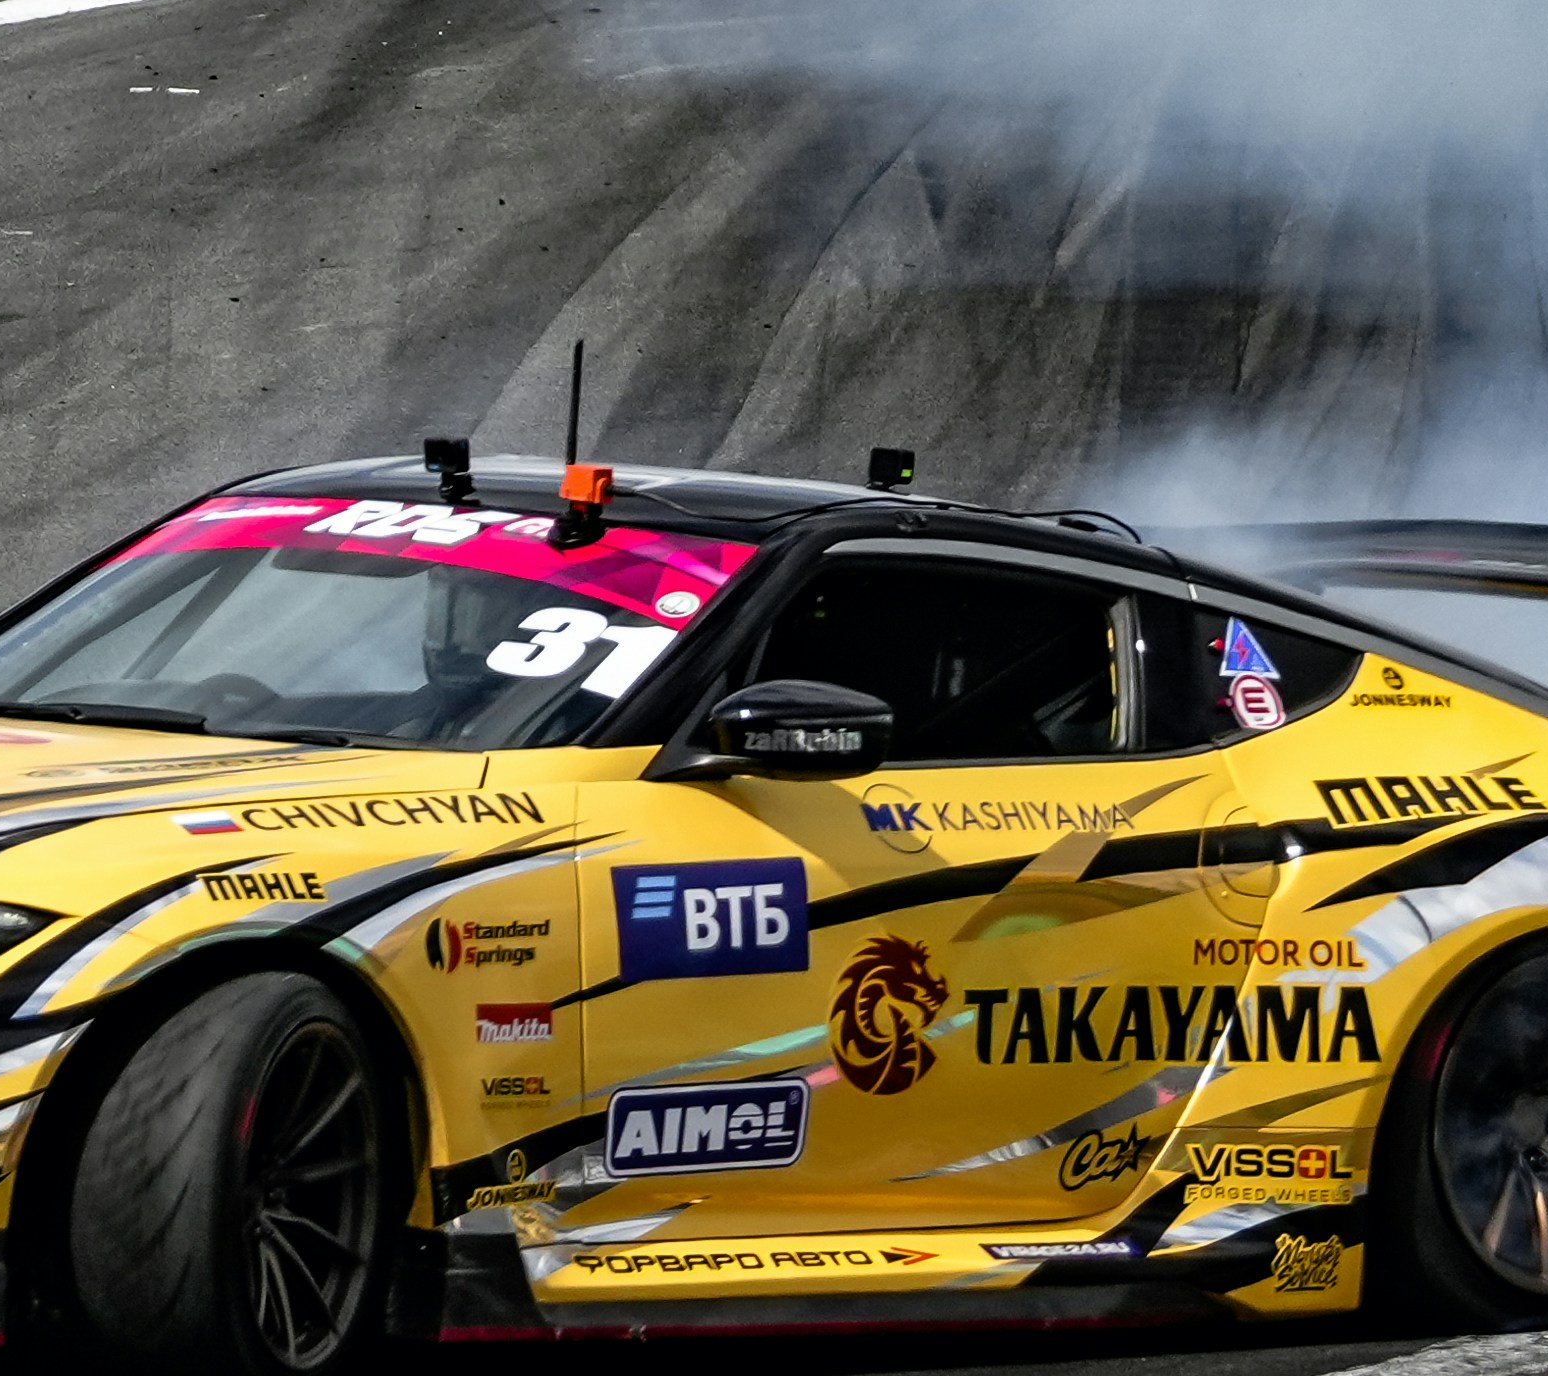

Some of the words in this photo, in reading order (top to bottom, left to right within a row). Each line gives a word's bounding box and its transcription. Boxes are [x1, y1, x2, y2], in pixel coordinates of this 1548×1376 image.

[303, 500, 523, 545] RDS
[486, 607, 679, 699] 31
[1241, 686, 1270, 714] E
[1350, 693, 1452, 708] JONNESWAY
[241, 792, 545, 831] CHIVCHYAN
[1314, 775, 1546, 824] MAHLE
[859, 801, 933, 832] MK
[933, 801, 1135, 832] KASHIYAMA
[203, 872, 325, 901] MAHLE
[463, 919, 551, 939] Standard
[683, 882, 790, 952] ВТБ
[465, 945, 536, 968] Springs
[1194, 938, 1300, 967] MOTOR
[1309, 939, 1365, 968] OIL
[964, 985, 1384, 1066] TAKAYAMA
[481, 1076, 551, 1096] VISSOL
[614, 1100, 795, 1159] AIMOL
[1188, 1145, 1353, 1181] VISSOL
[1186, 1186, 1266, 1203] FORGED
[1277, 1188, 1353, 1203] WHEELS
[573, 1250, 764, 1274] ФОРВАРД
[770, 1250, 873, 1269] АВТО
